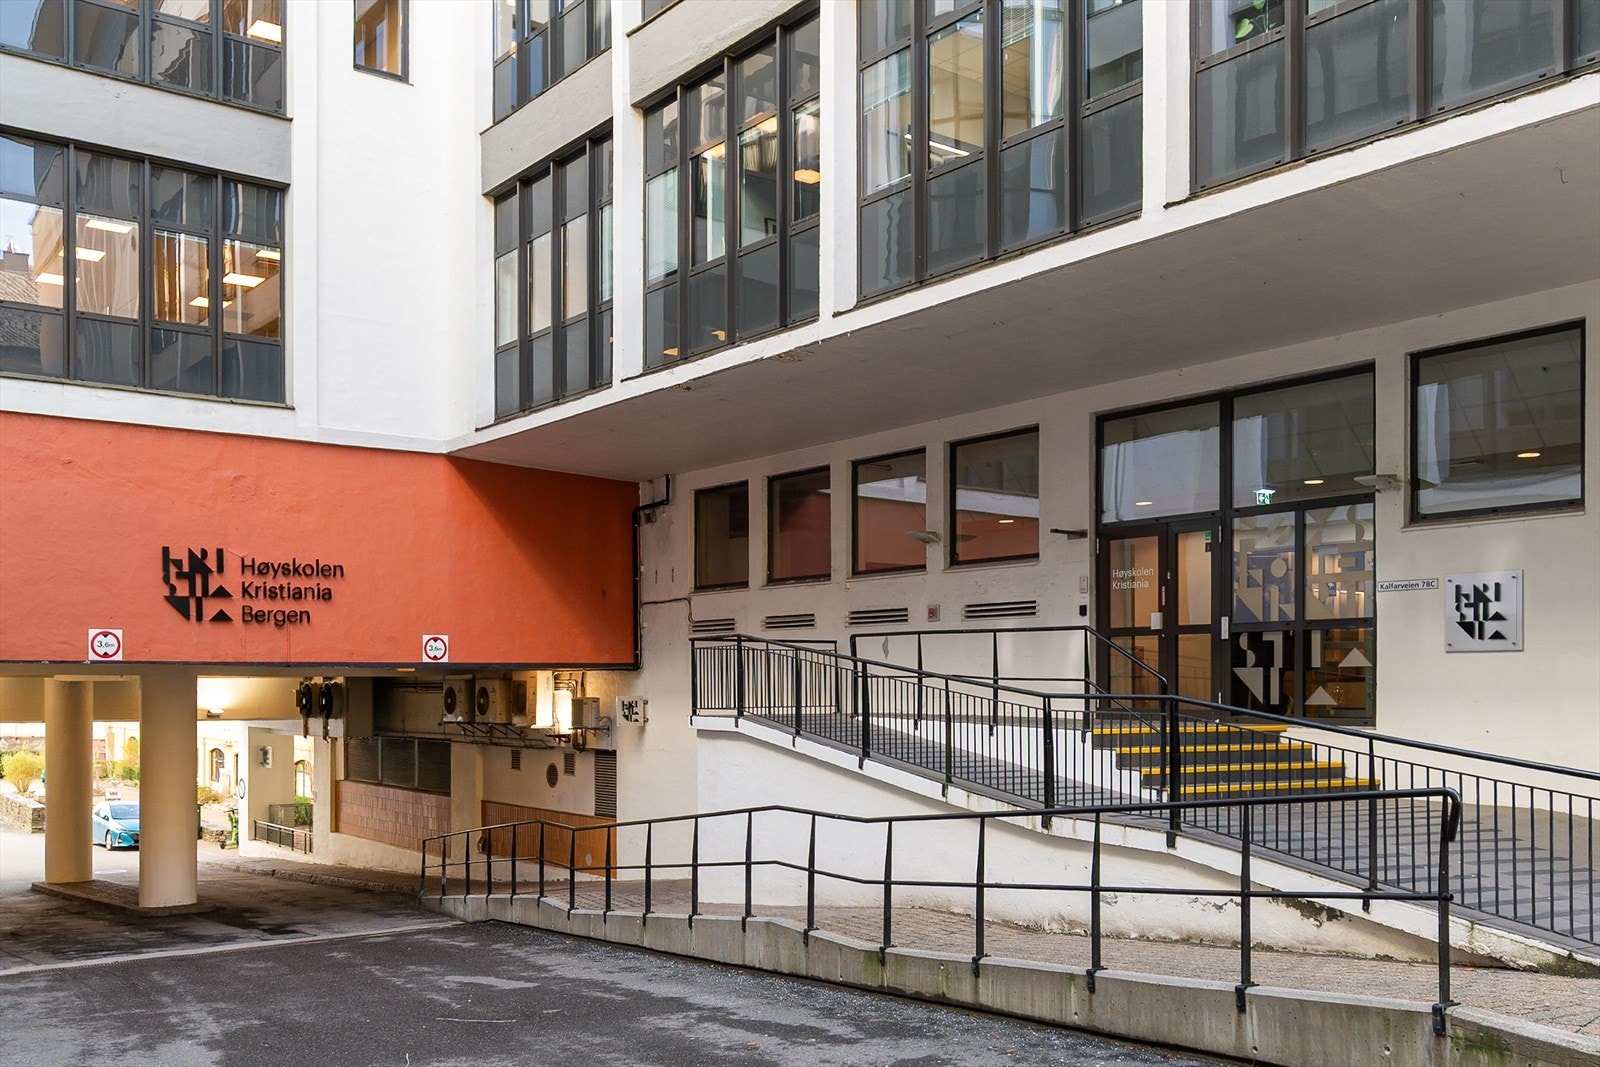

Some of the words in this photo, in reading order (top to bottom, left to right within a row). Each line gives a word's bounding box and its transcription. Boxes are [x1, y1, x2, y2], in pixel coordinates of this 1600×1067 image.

[241, 557, 345, 579] Høyskolen
[1112, 567, 1154, 579] Høyskolen
[241, 581, 333, 601] Kristiania
[1112, 579, 1149, 590] Kristiania
[1380, 582, 1420, 590] Kalfarveien
[1421, 580, 1436, 588] 78C
[241, 605, 311, 627] Bergen
